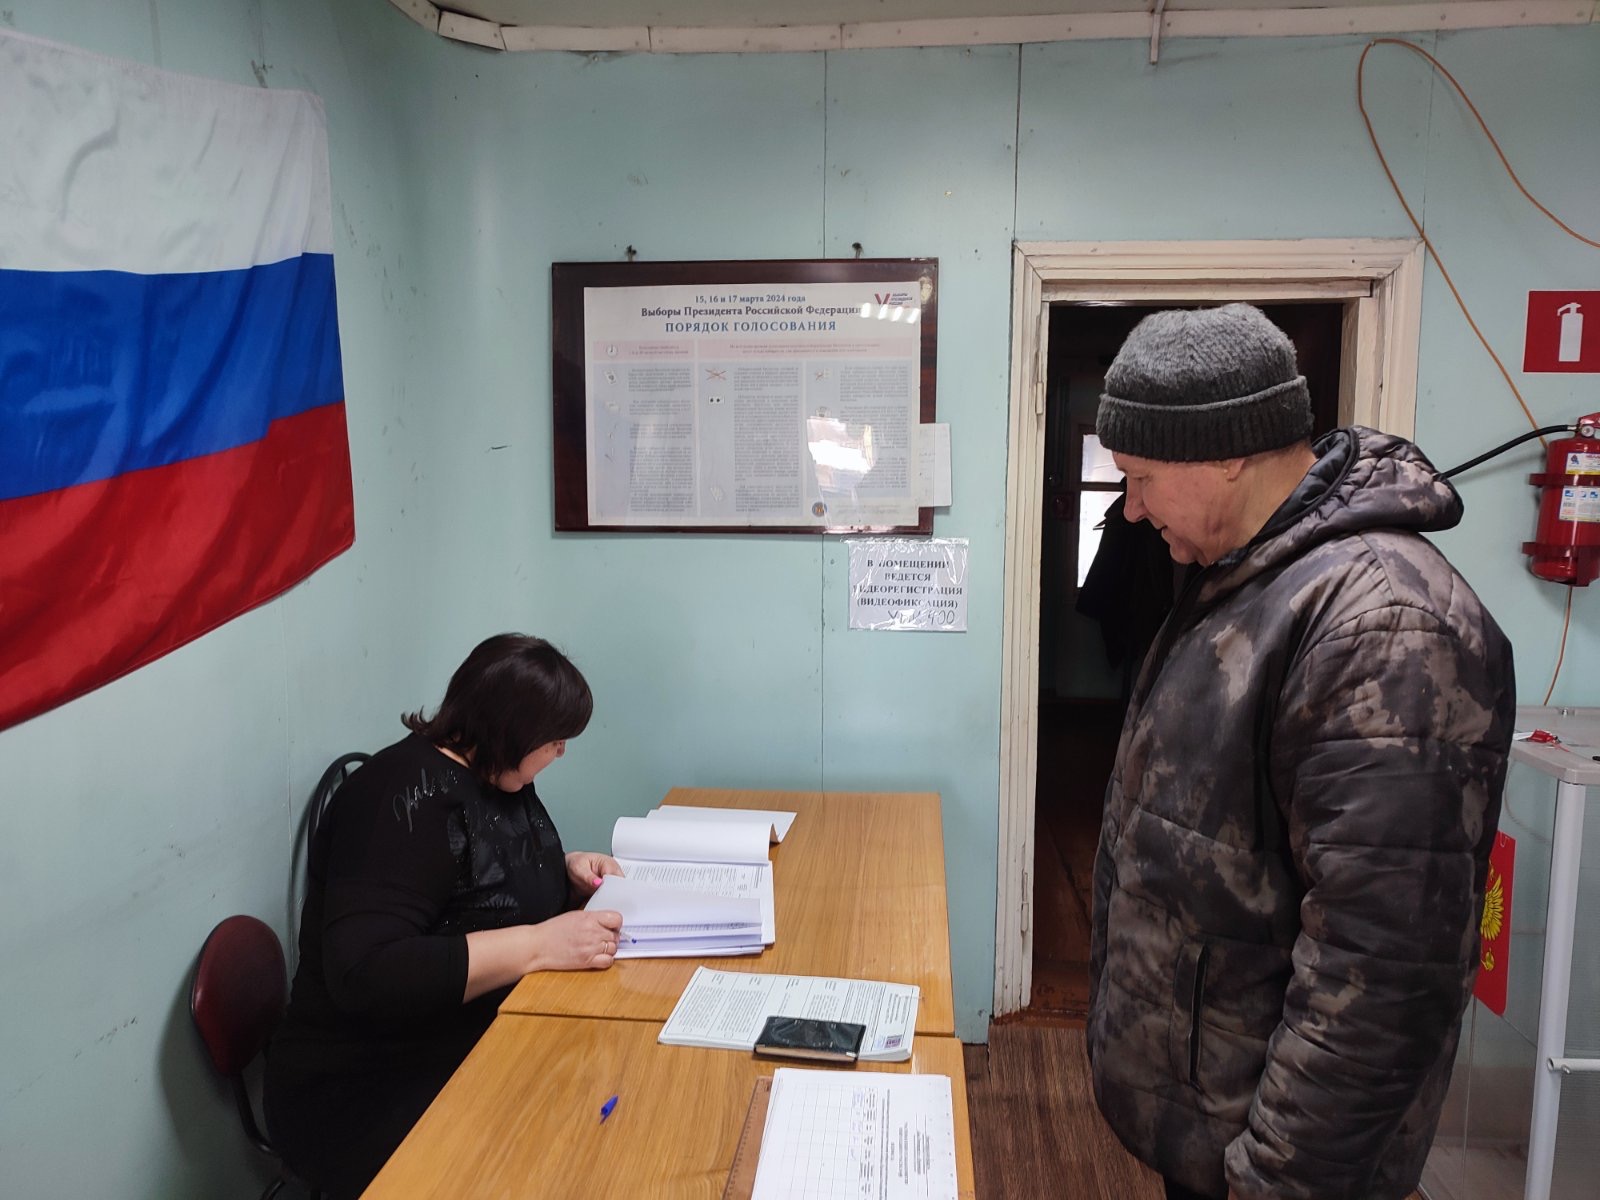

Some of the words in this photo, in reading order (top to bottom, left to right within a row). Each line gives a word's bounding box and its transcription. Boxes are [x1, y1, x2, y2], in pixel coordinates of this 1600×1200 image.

[695, 295, 707, 304] 15,
[709, 295, 718, 303] 16
[728, 294, 738, 303] 17
[739, 296, 765, 304] марта
[766, 294, 786, 302] 2024
[641, 307, 681, 318] Выборы
[684, 306, 743, 318] Президента
[745, 306, 803, 315] Российской
[665, 321, 729, 334] ПОРЯДОК
[734, 320, 836, 333] ГОЛОСОВАНИЯ
[867, 559, 874, 567] В
[885, 572, 931, 582] ВЕДЕТСЯ
